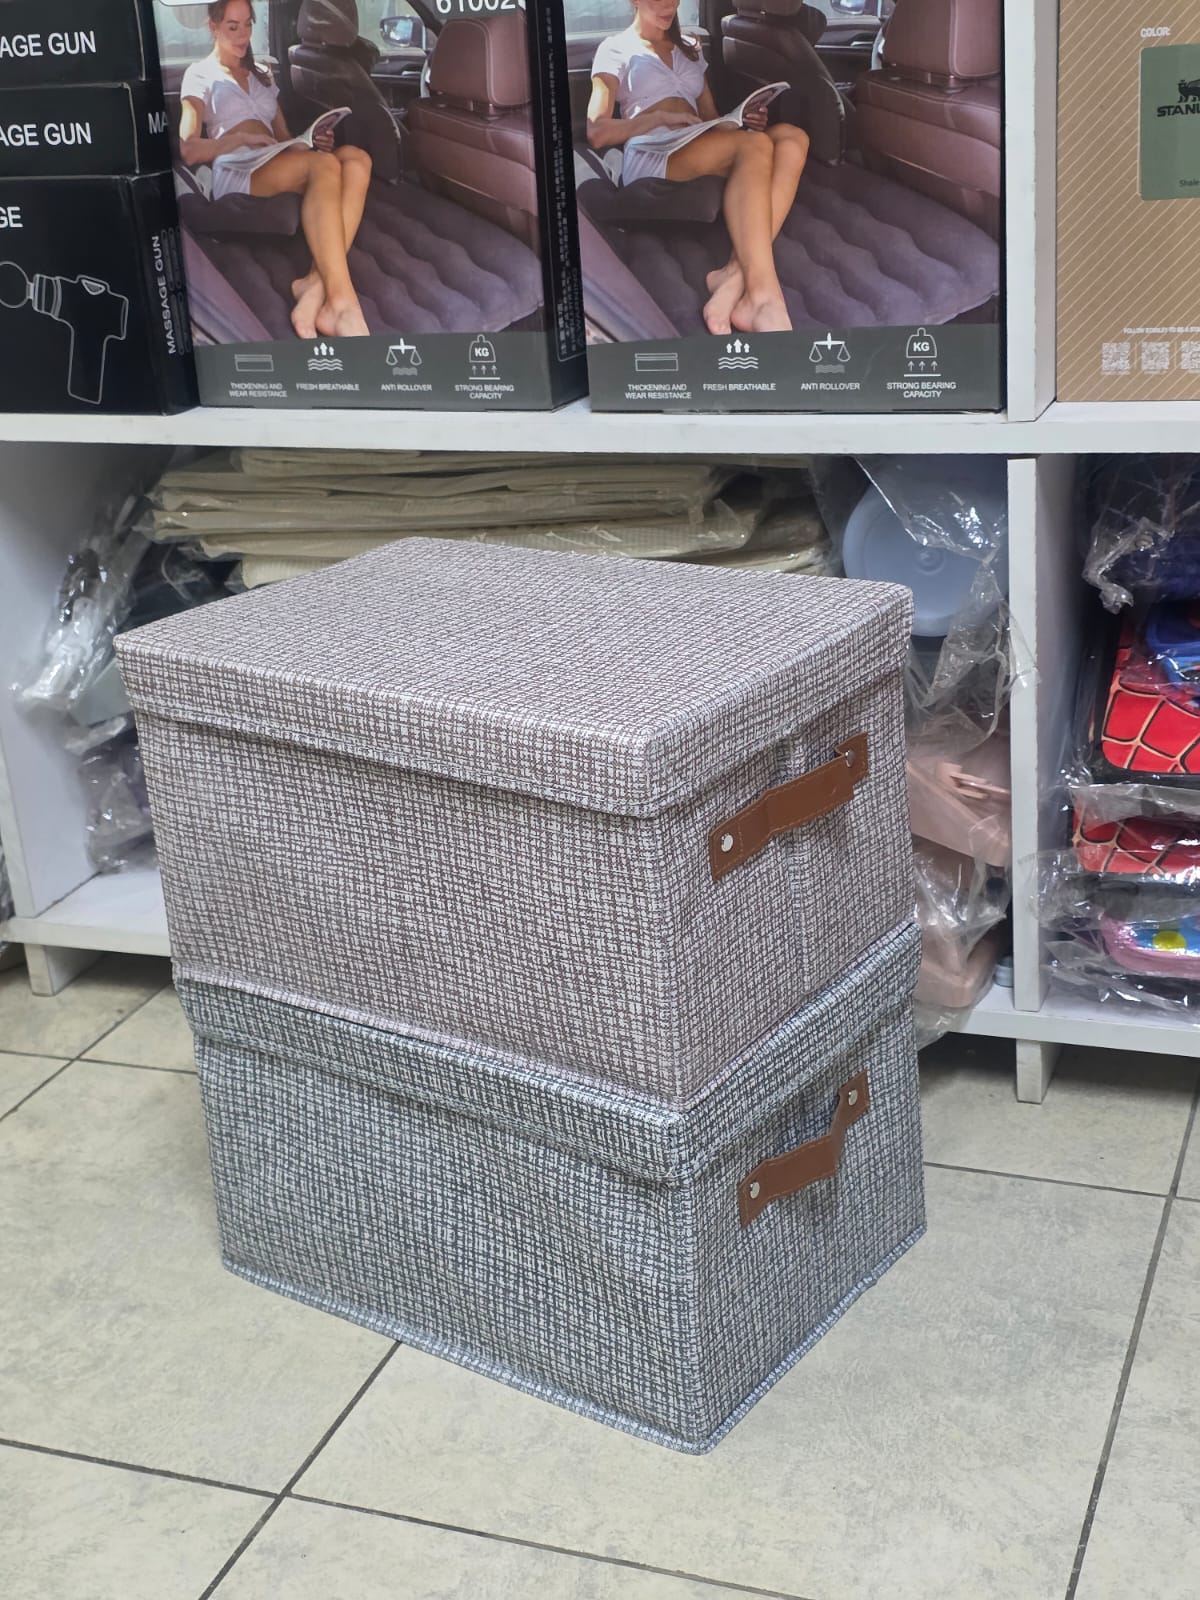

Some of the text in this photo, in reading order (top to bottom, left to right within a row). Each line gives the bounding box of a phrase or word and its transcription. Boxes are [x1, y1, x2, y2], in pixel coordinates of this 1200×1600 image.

[0, 30, 97, 58] AGE GUN
[44, 121, 92, 146] GUN
[152, 235, 176, 354] MASSAGE GUN
[912, 341, 930, 352] KG
[474, 347, 490, 357] KG
[230, 382, 268, 390] THICKENING
[296, 383, 360, 391] FRESH BREATHABLE
[455, 384, 514, 392] STRONG BEARING
[627, 383, 687, 391] THICKENING AND
[703, 383, 777, 391] FRESH BREATHABLE
[800, 383, 860, 391] ANTI ROLLOVER
[887, 382, 956, 390] STRONG BEARING
[249, 390, 287, 398] RESISTANCE
[469, 392, 502, 400] CAPACITY
[625, 391, 692, 400] WEAR RESISTANCE
[903, 390, 942, 398] CAPACITY
